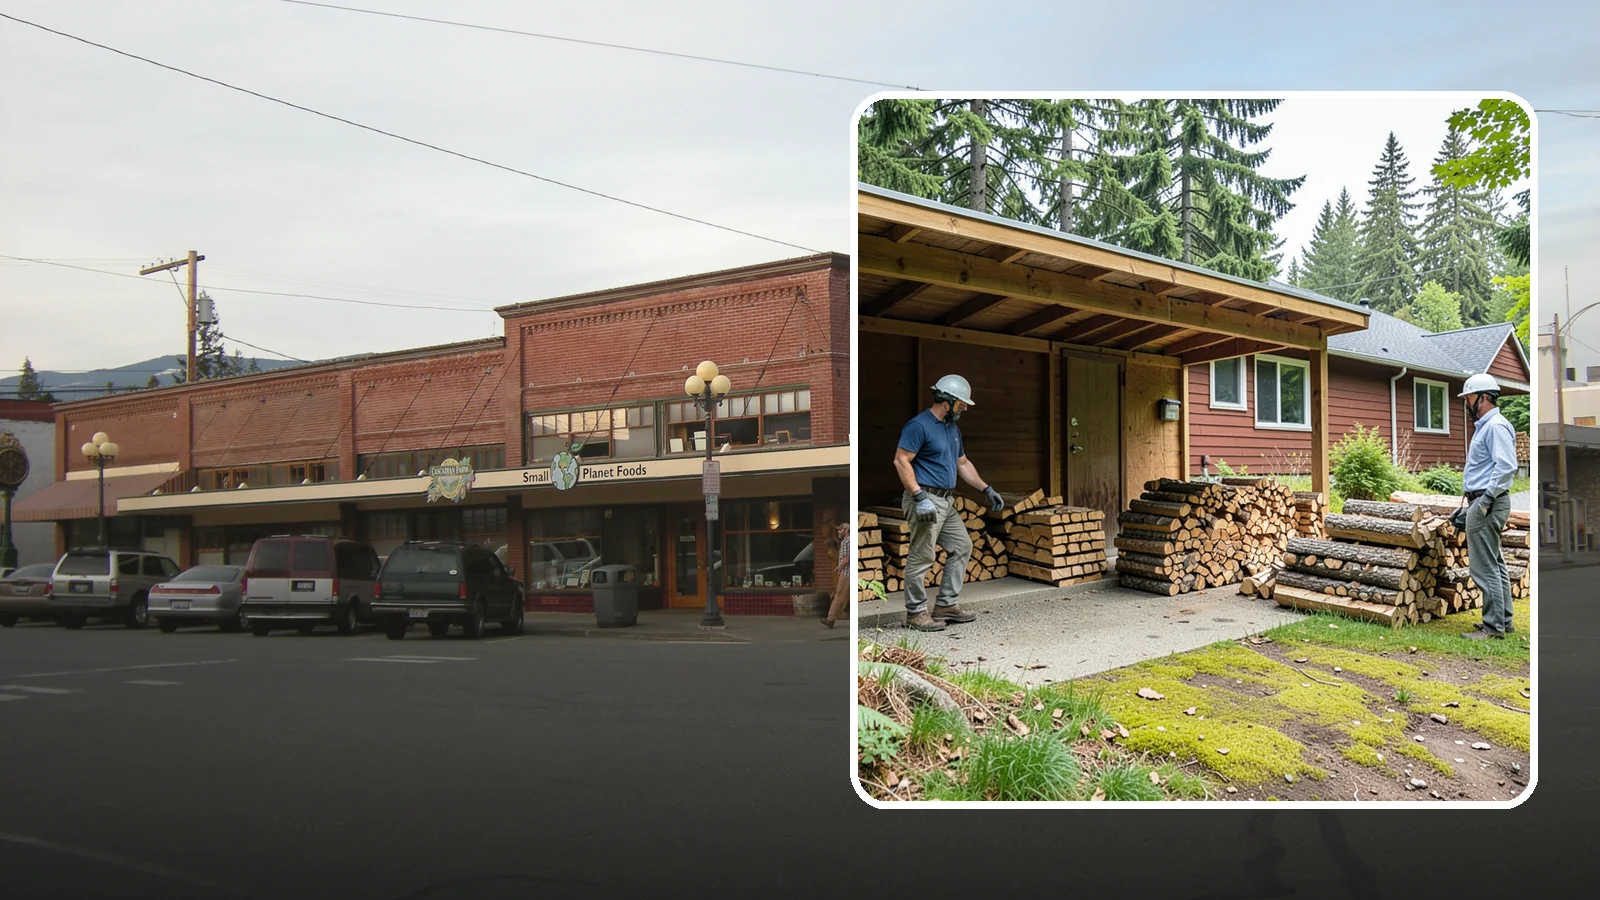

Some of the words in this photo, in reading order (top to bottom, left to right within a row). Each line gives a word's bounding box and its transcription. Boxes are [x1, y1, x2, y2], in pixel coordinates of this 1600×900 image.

[456, 465, 469, 474] FARM
[523, 470, 549, 483] Small
[583, 467, 614, 479] Planet
[617, 464, 647, 477] Foods
